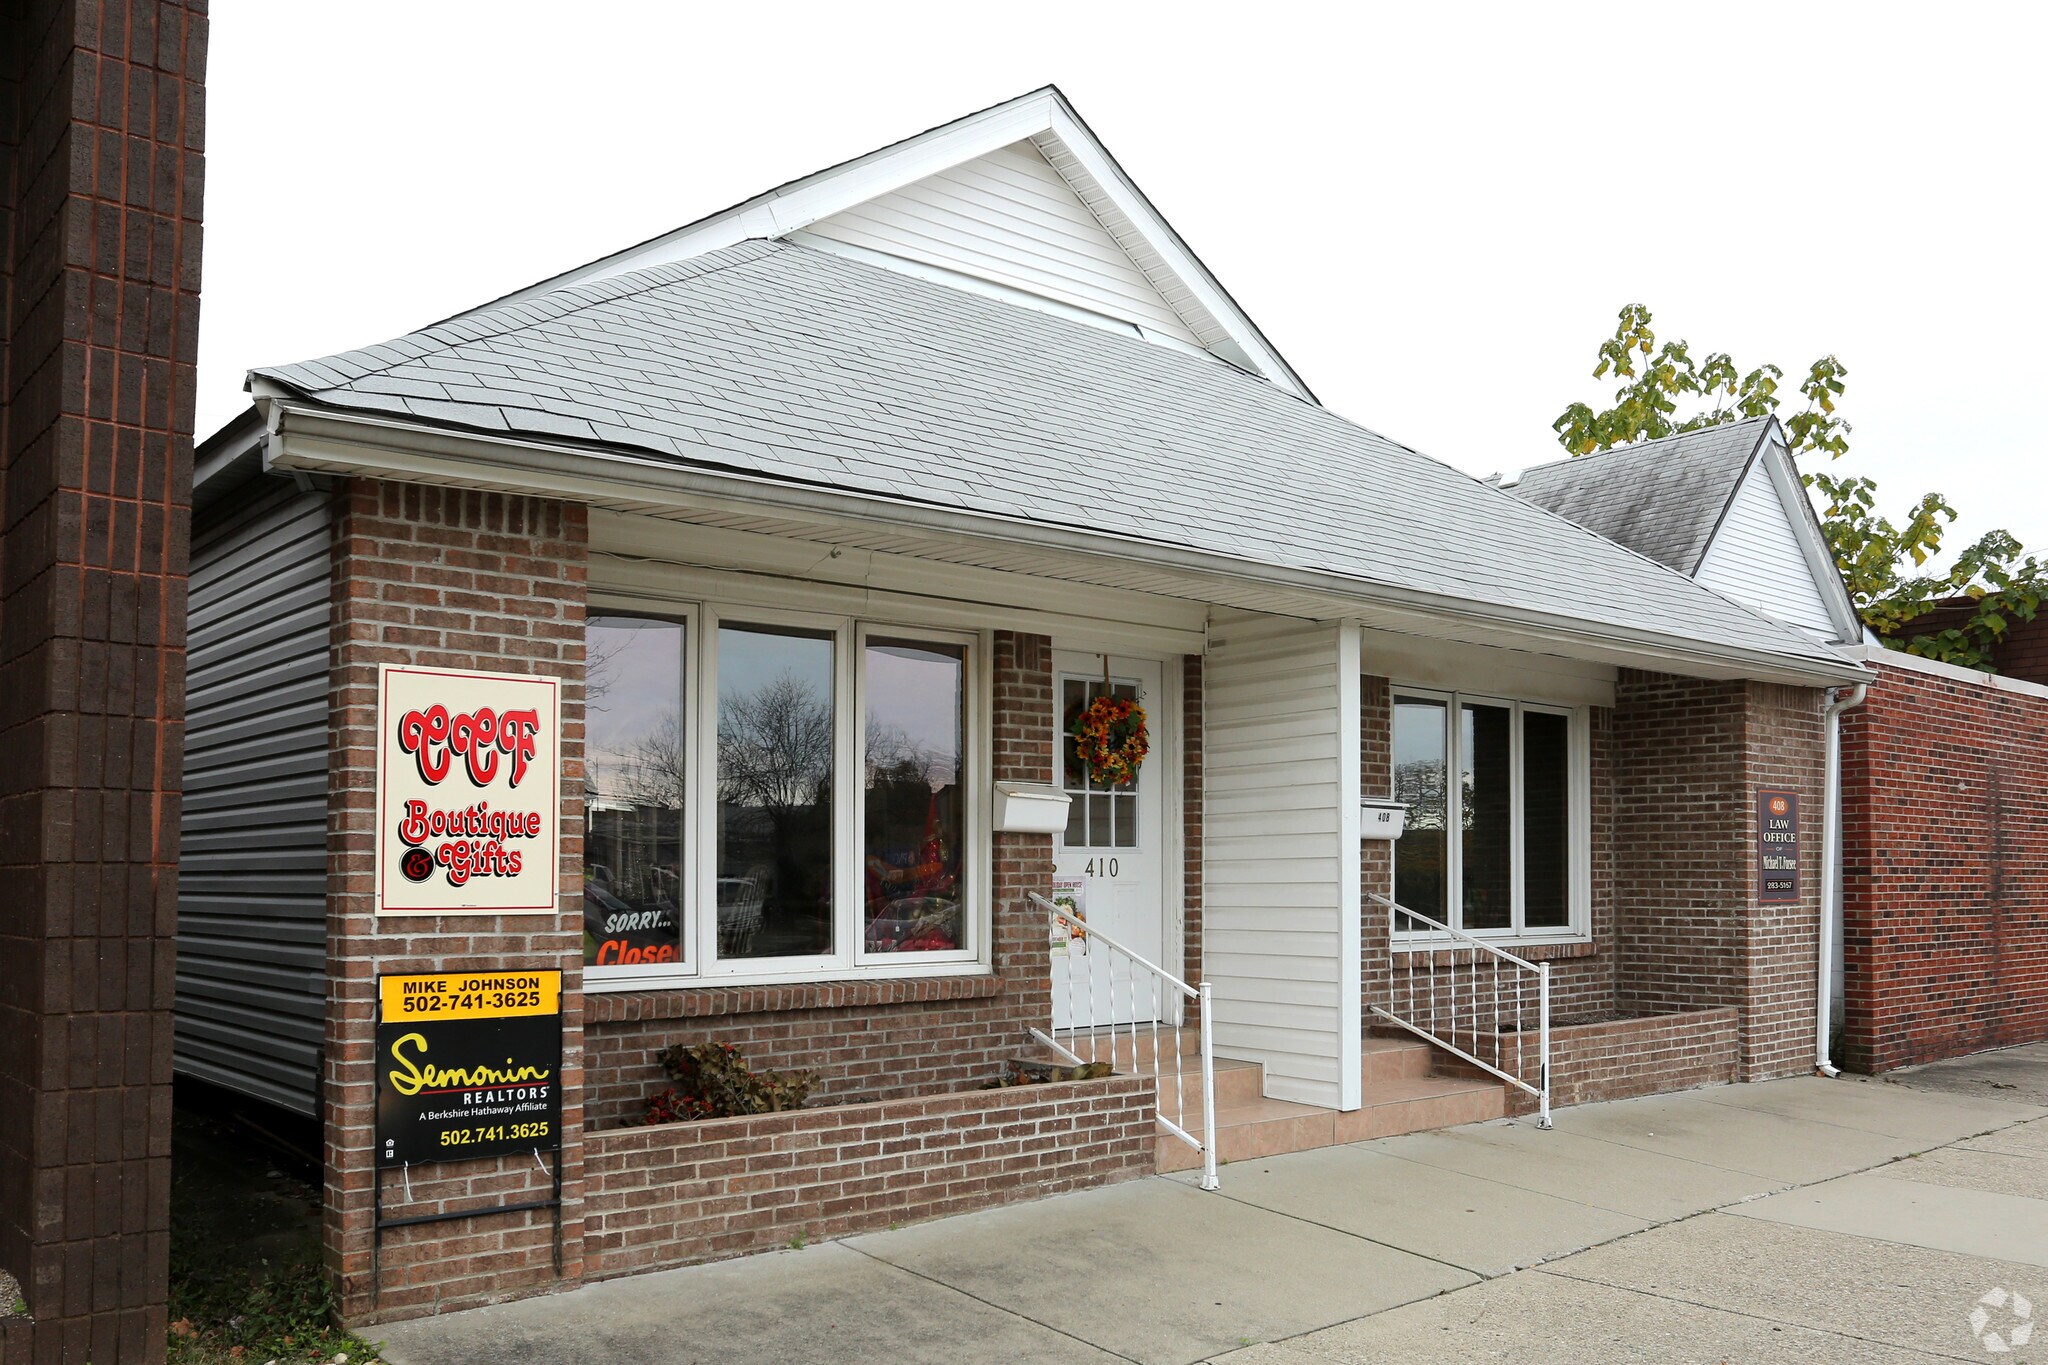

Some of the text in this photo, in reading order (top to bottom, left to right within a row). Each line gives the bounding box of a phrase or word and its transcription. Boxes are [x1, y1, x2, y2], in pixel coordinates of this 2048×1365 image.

[398, 703, 540, 789] CCF
[1772, 800, 1785, 811] 408
[398, 799, 541, 846] Boutique
[1769, 819, 1789, 829] LAW
[1763, 832, 1796, 843] OFFICE
[405, 840, 523, 887] & Gifts
[1085, 858, 1119, 877] 410
[604, 911, 671, 933] SORRY...
[403, 978, 540, 994] MIKE JOHNSON
[403, 992, 540, 1012] 502-741-3625
[389, 1033, 549, 1095] Semonin
[464, 1086, 548, 1105] REALTORS
[419, 1102, 547, 1121] A Berkshire Hathaway Affiliate
[440, 1122, 549, 1146] 502.741.3625
